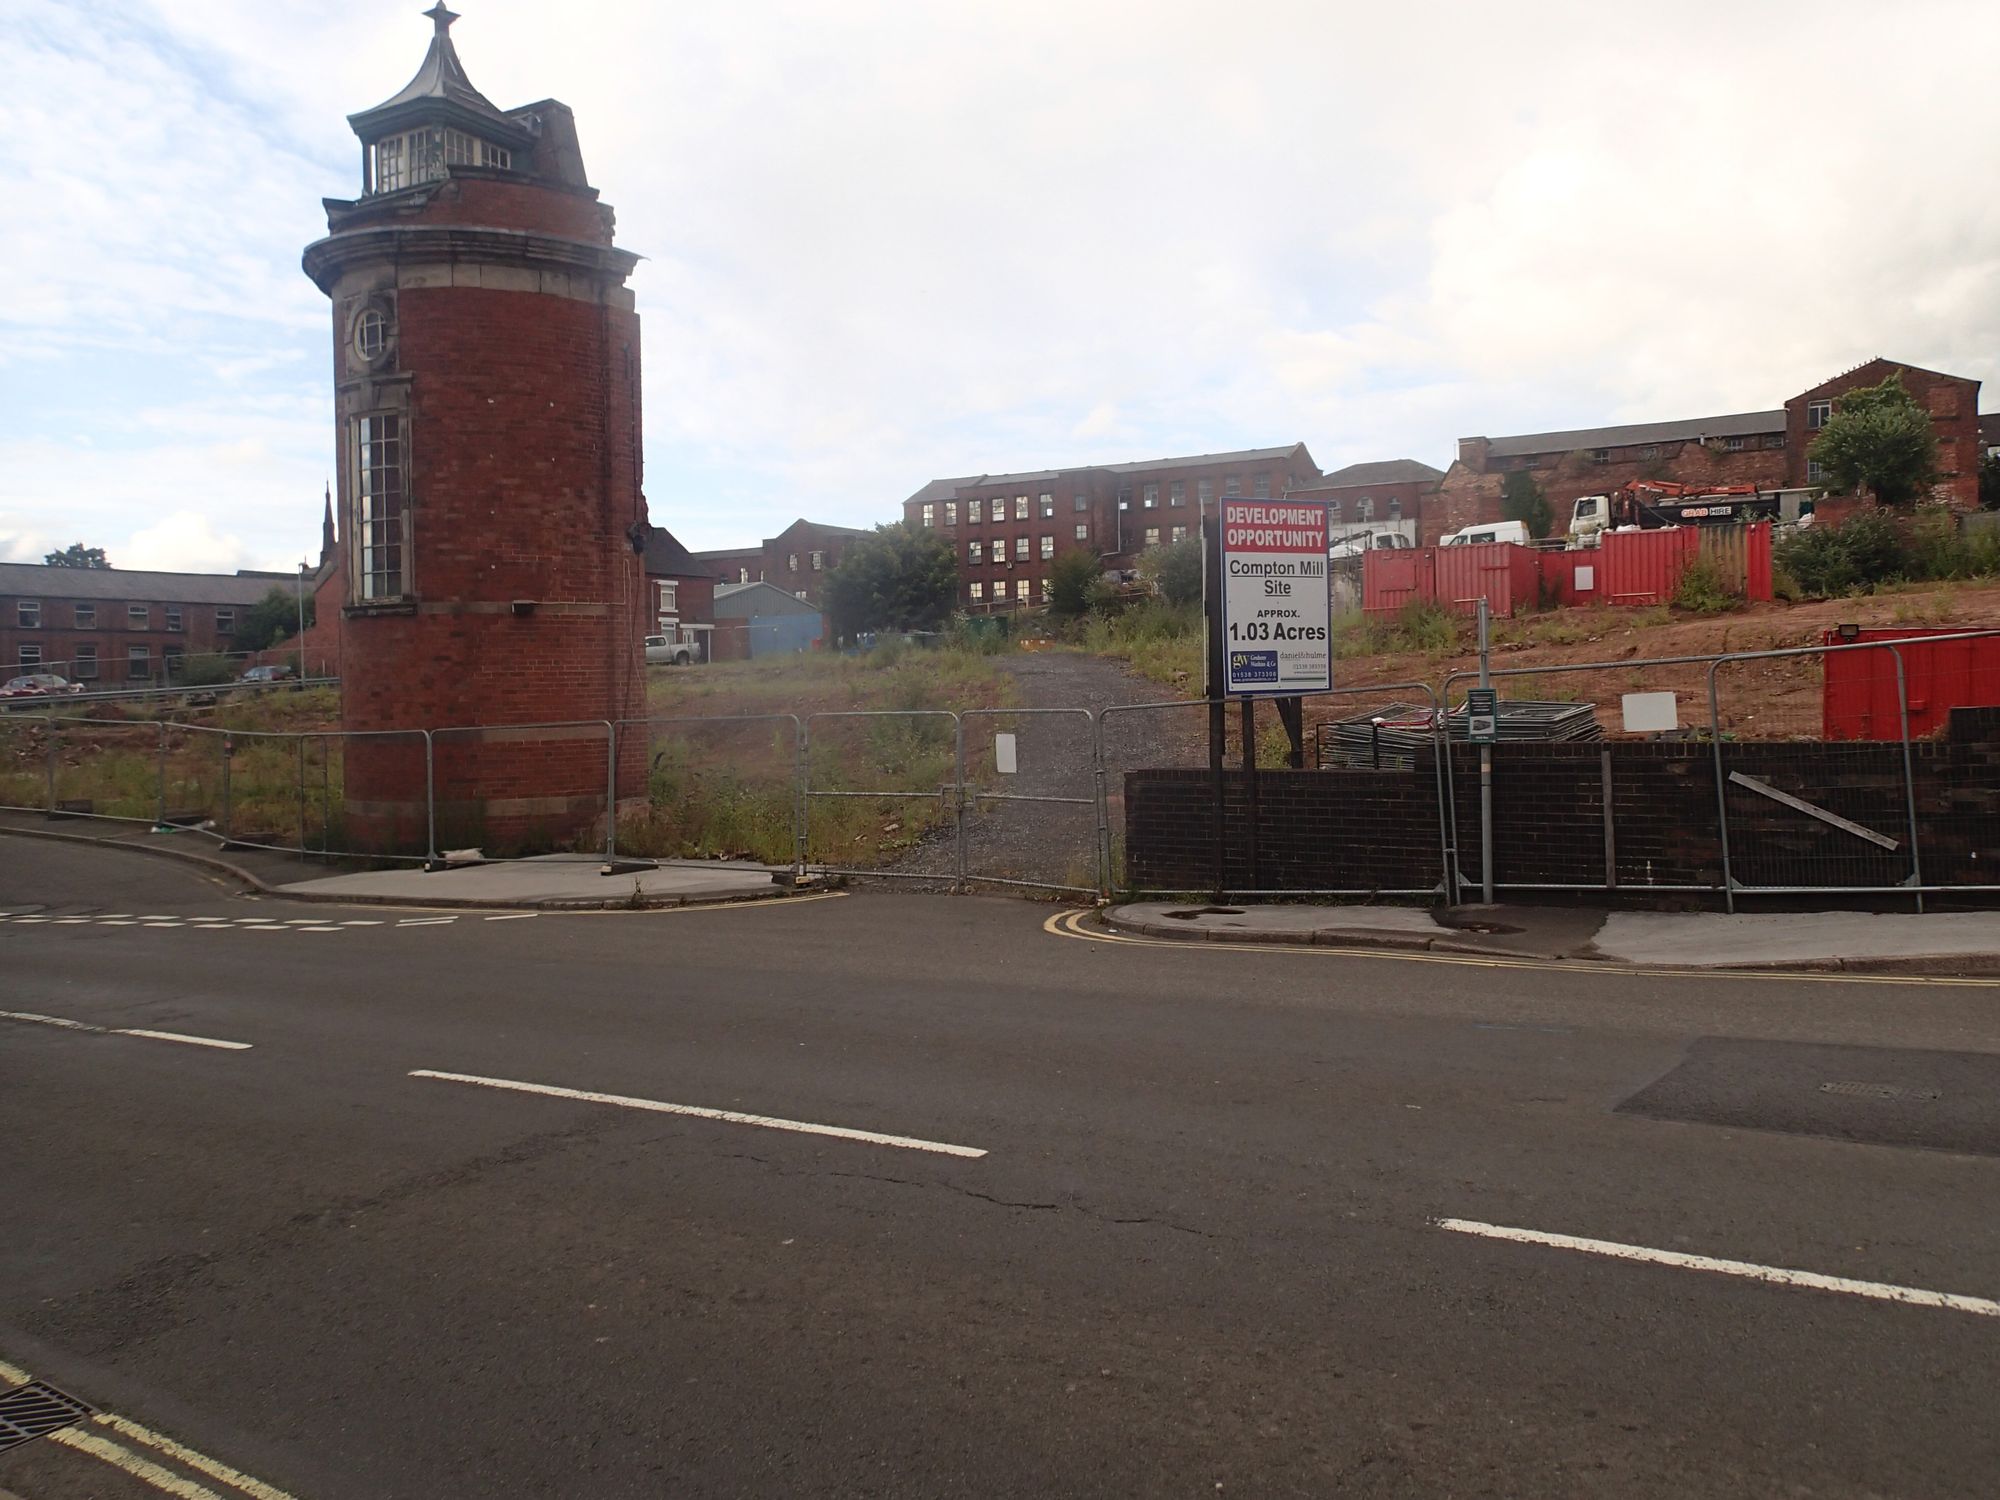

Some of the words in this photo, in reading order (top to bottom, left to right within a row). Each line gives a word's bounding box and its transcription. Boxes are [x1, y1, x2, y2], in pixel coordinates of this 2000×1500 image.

[1227, 507, 1323, 525] DEVELOPMENT
[1682, 508, 1708, 517] GRAB
[1710, 507, 1731, 516] HIRE
[1227, 529, 1324, 547] OPPORTUNITY
[1230, 560, 1295, 578] Compton
[1300, 561, 1323, 575] Mill
[1264, 580, 1291, 594] Site
[1257, 609, 1300, 618] APPROX.
[1230, 622, 1269, 640] 1.03
[1273, 622, 1326, 640] Acres
